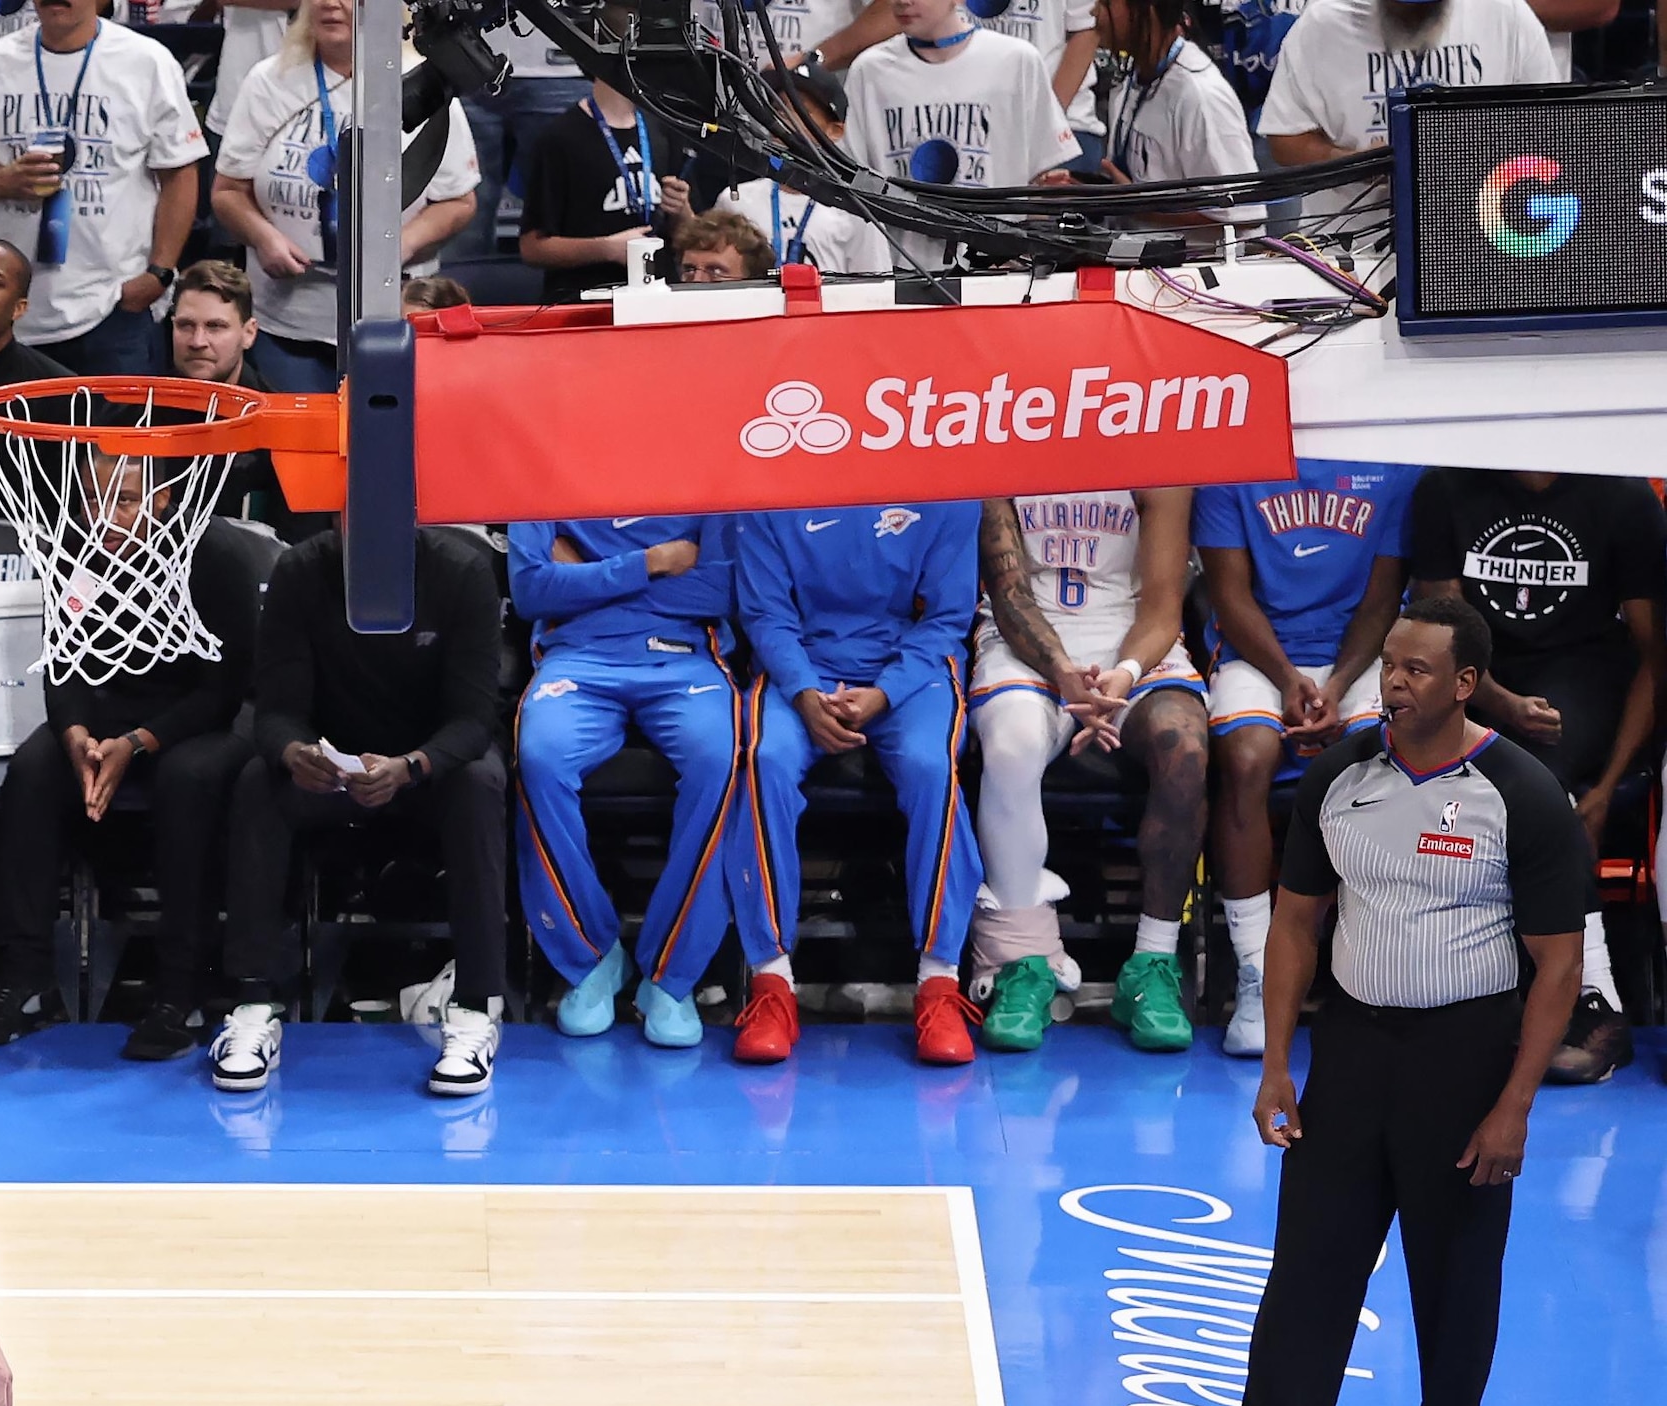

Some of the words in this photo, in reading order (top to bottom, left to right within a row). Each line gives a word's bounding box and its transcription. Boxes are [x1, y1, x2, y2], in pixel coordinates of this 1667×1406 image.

[883, 102, 990, 152] PLAYOFFS
[86, 145, 104, 169] 26
[964, 155, 985, 182] 26
[1018, 499, 1136, 536] KLAHOMA
[1257, 489, 1375, 538] THUNDER
[1041, 534, 1100, 568] CITY
[1476, 558, 1577, 582] THUNDER
[1056, 566, 1089, 614] 6
[1418, 836, 1473, 855] Emirates
